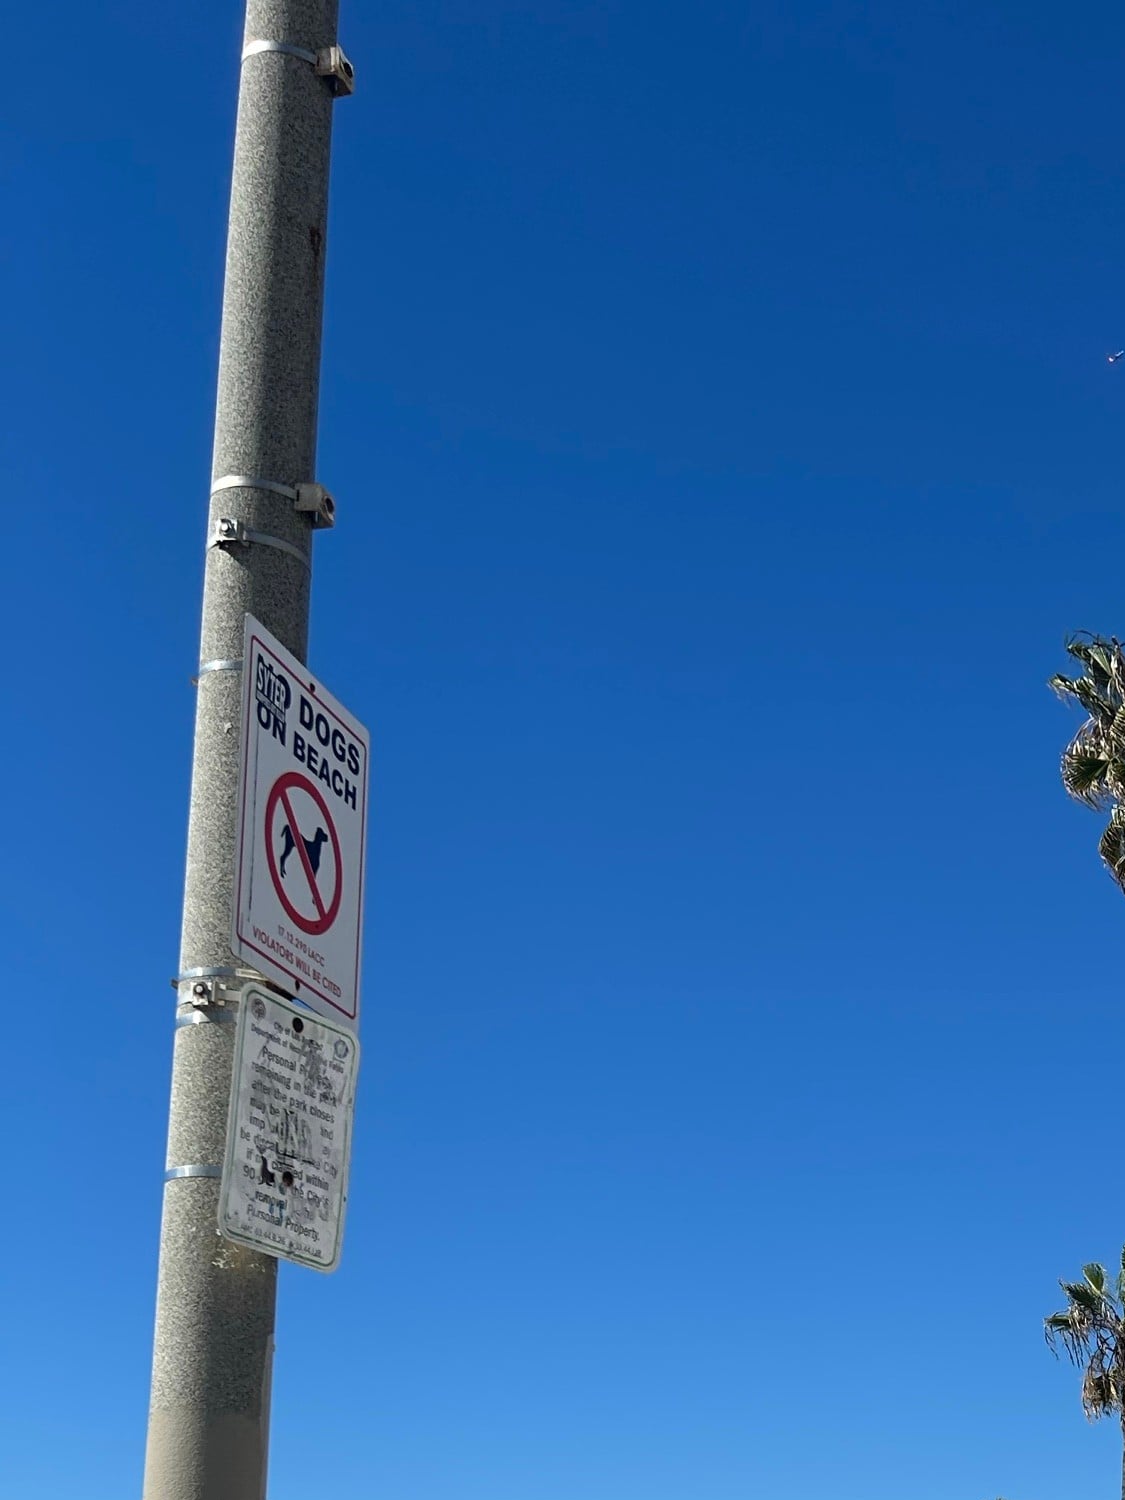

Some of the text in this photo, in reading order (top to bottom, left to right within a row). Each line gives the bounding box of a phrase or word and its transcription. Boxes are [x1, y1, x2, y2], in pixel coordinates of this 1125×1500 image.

[300, 694, 360, 777] DOGS
[257, 701, 286, 747] ON
[293, 730, 357, 811] BEACH
[252, 925, 342, 998] VIOLATORS WILL BE CITED
[307, 946, 325, 967] LACC
[262, 1046, 296, 1072] Personal
[252, 1061, 291, 1090] remaining
[294, 1080, 301, 1092] in
[251, 1079, 335, 1124] after the park closes
[269, 1104, 280, 1118] be
[240, 1128, 250, 1142] be
[243, 1166, 255, 1180] 90
[306, 1174, 329, 1191] within
